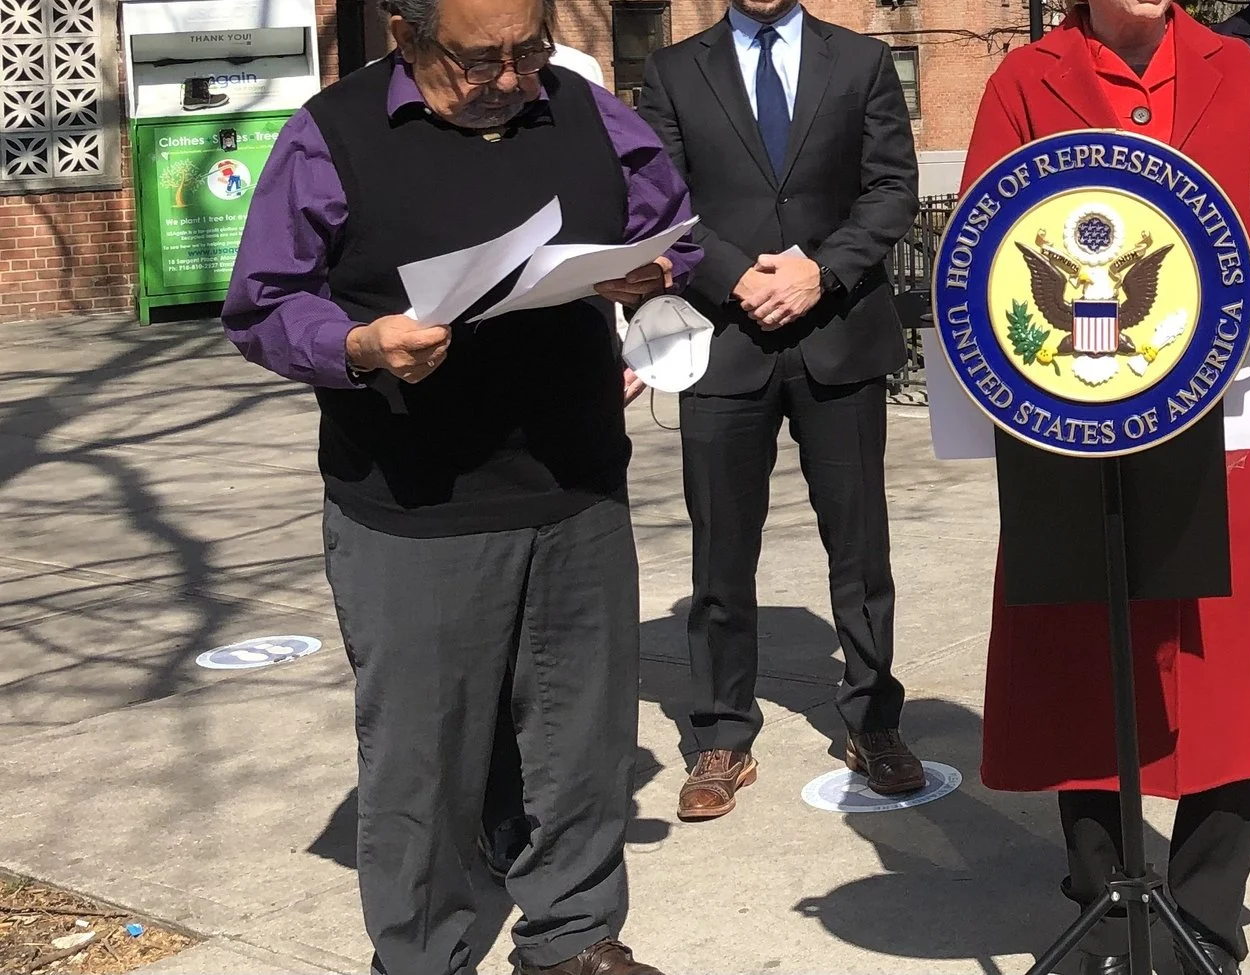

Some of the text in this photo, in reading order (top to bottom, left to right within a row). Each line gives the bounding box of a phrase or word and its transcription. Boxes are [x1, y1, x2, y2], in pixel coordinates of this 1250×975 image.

[189, 33, 252, 43] THANK YOU!
[209, 71, 257, 89] again
[158, 136, 205, 148] Clothes
[212, 133, 248, 145] Ses
[165, 218, 179, 226] We
[180, 216, 201, 226] plant
[208, 215, 224, 223] tree
[945, 143, 1246, 290] HOUSE OF REPRESENTATIVES
[947, 297, 1244, 446] UNITED STATES OF AMERICA
